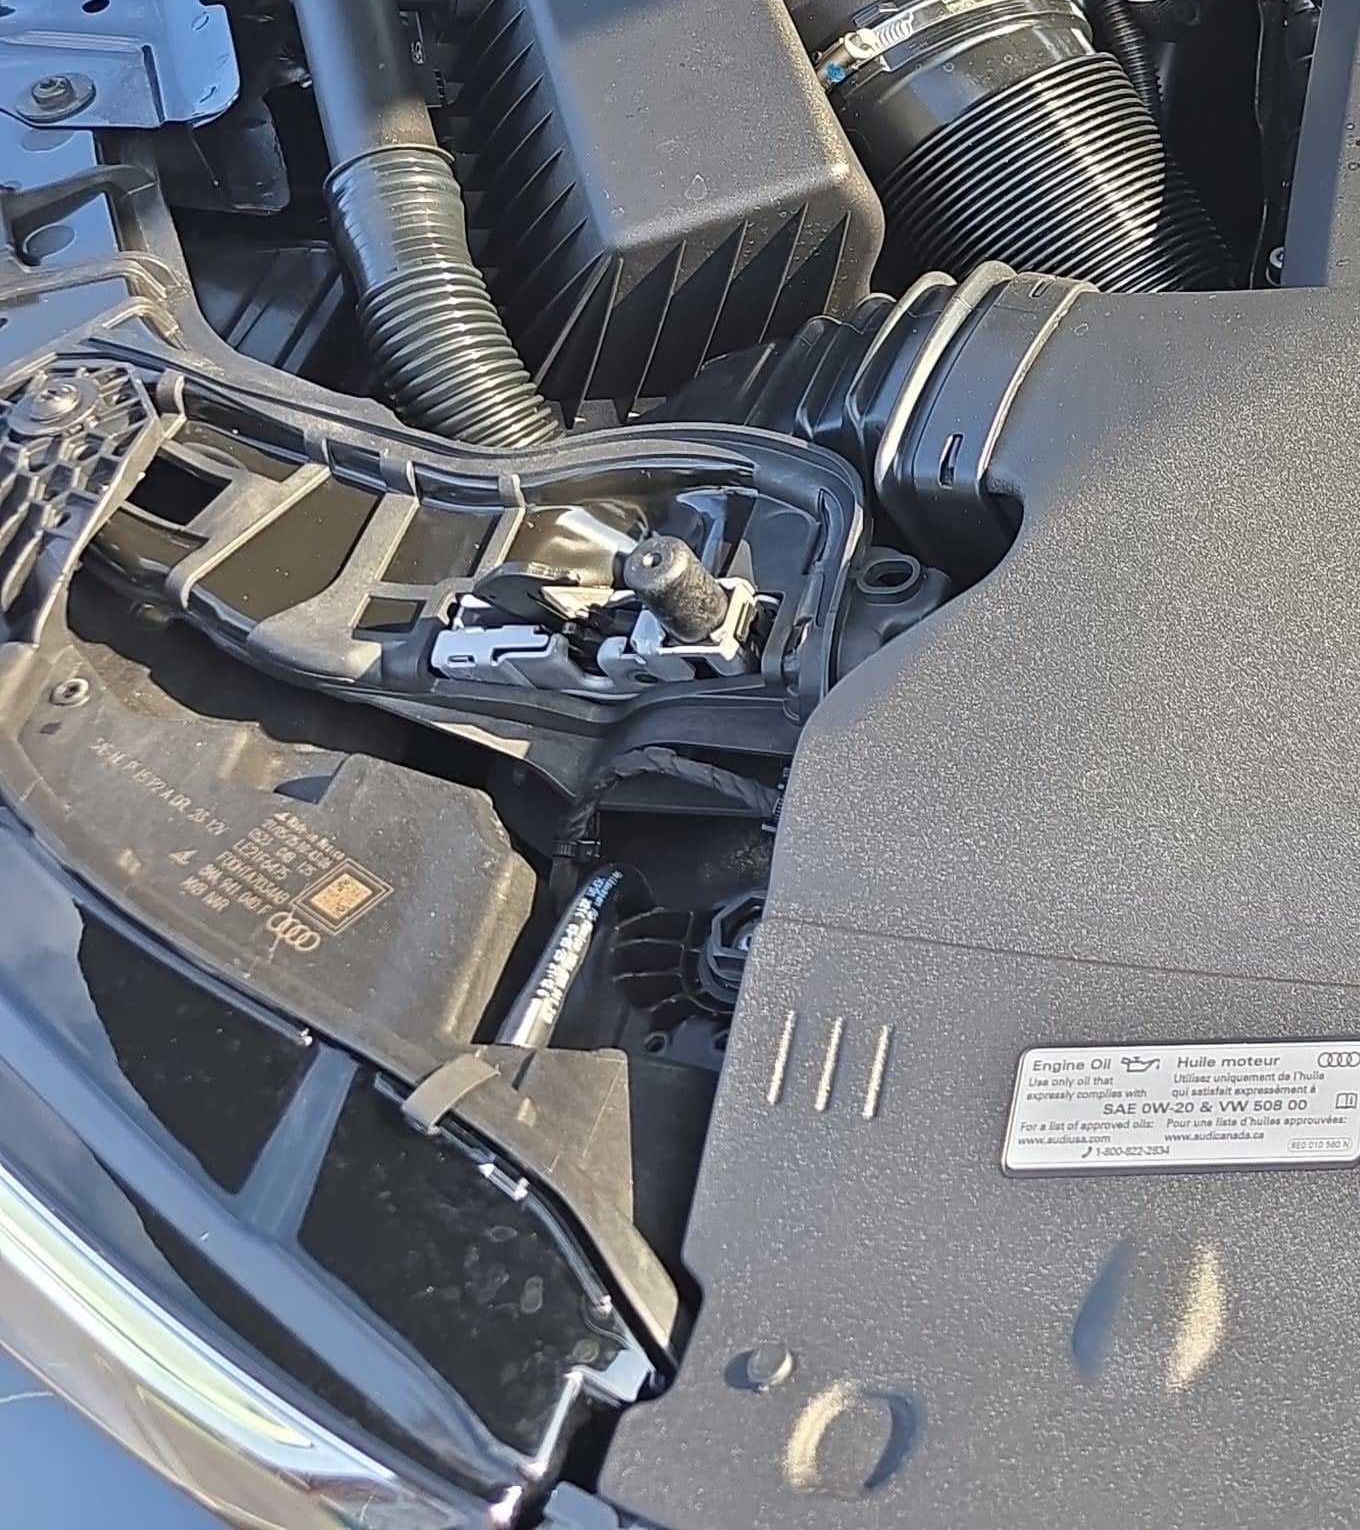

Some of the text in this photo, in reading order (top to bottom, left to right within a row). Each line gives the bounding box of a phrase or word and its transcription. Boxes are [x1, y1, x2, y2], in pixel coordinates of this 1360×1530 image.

[1032, 1058, 1112, 1073] Engine Oil
[1177, 1056, 1280, 1069] Huile moteur
[1028, 1076, 1114, 1088] Use only oil that
[1173, 1072, 1211, 1084] Utilisez
[1213, 1072, 1276, 1085] uniquement
[1278, 1072, 1291, 1082] de
[1026, 1088, 1148, 1101] expressly complies with
[1171, 1087, 1189, 1098] qui
[1191, 1085, 1233, 1097] satisfait
[1102, 1098, 1308, 1115] SAE 0W-20 & VW 508 00
[1020, 1121, 1038, 1132] For
[1050, 1120, 1065, 1131] list
[1070, 1120, 1078, 1131] of
[1080, 1120, 1130, 1132] approved
[1166, 1117, 1191, 1128] Pour
[1193, 1119, 1213, 1128] une
[1215, 1116, 1238, 1127] liste
[1017, 1135, 1111, 1145] www.audiusa.com
[1163, 1130, 1265, 1142] www.audicanada.ca
